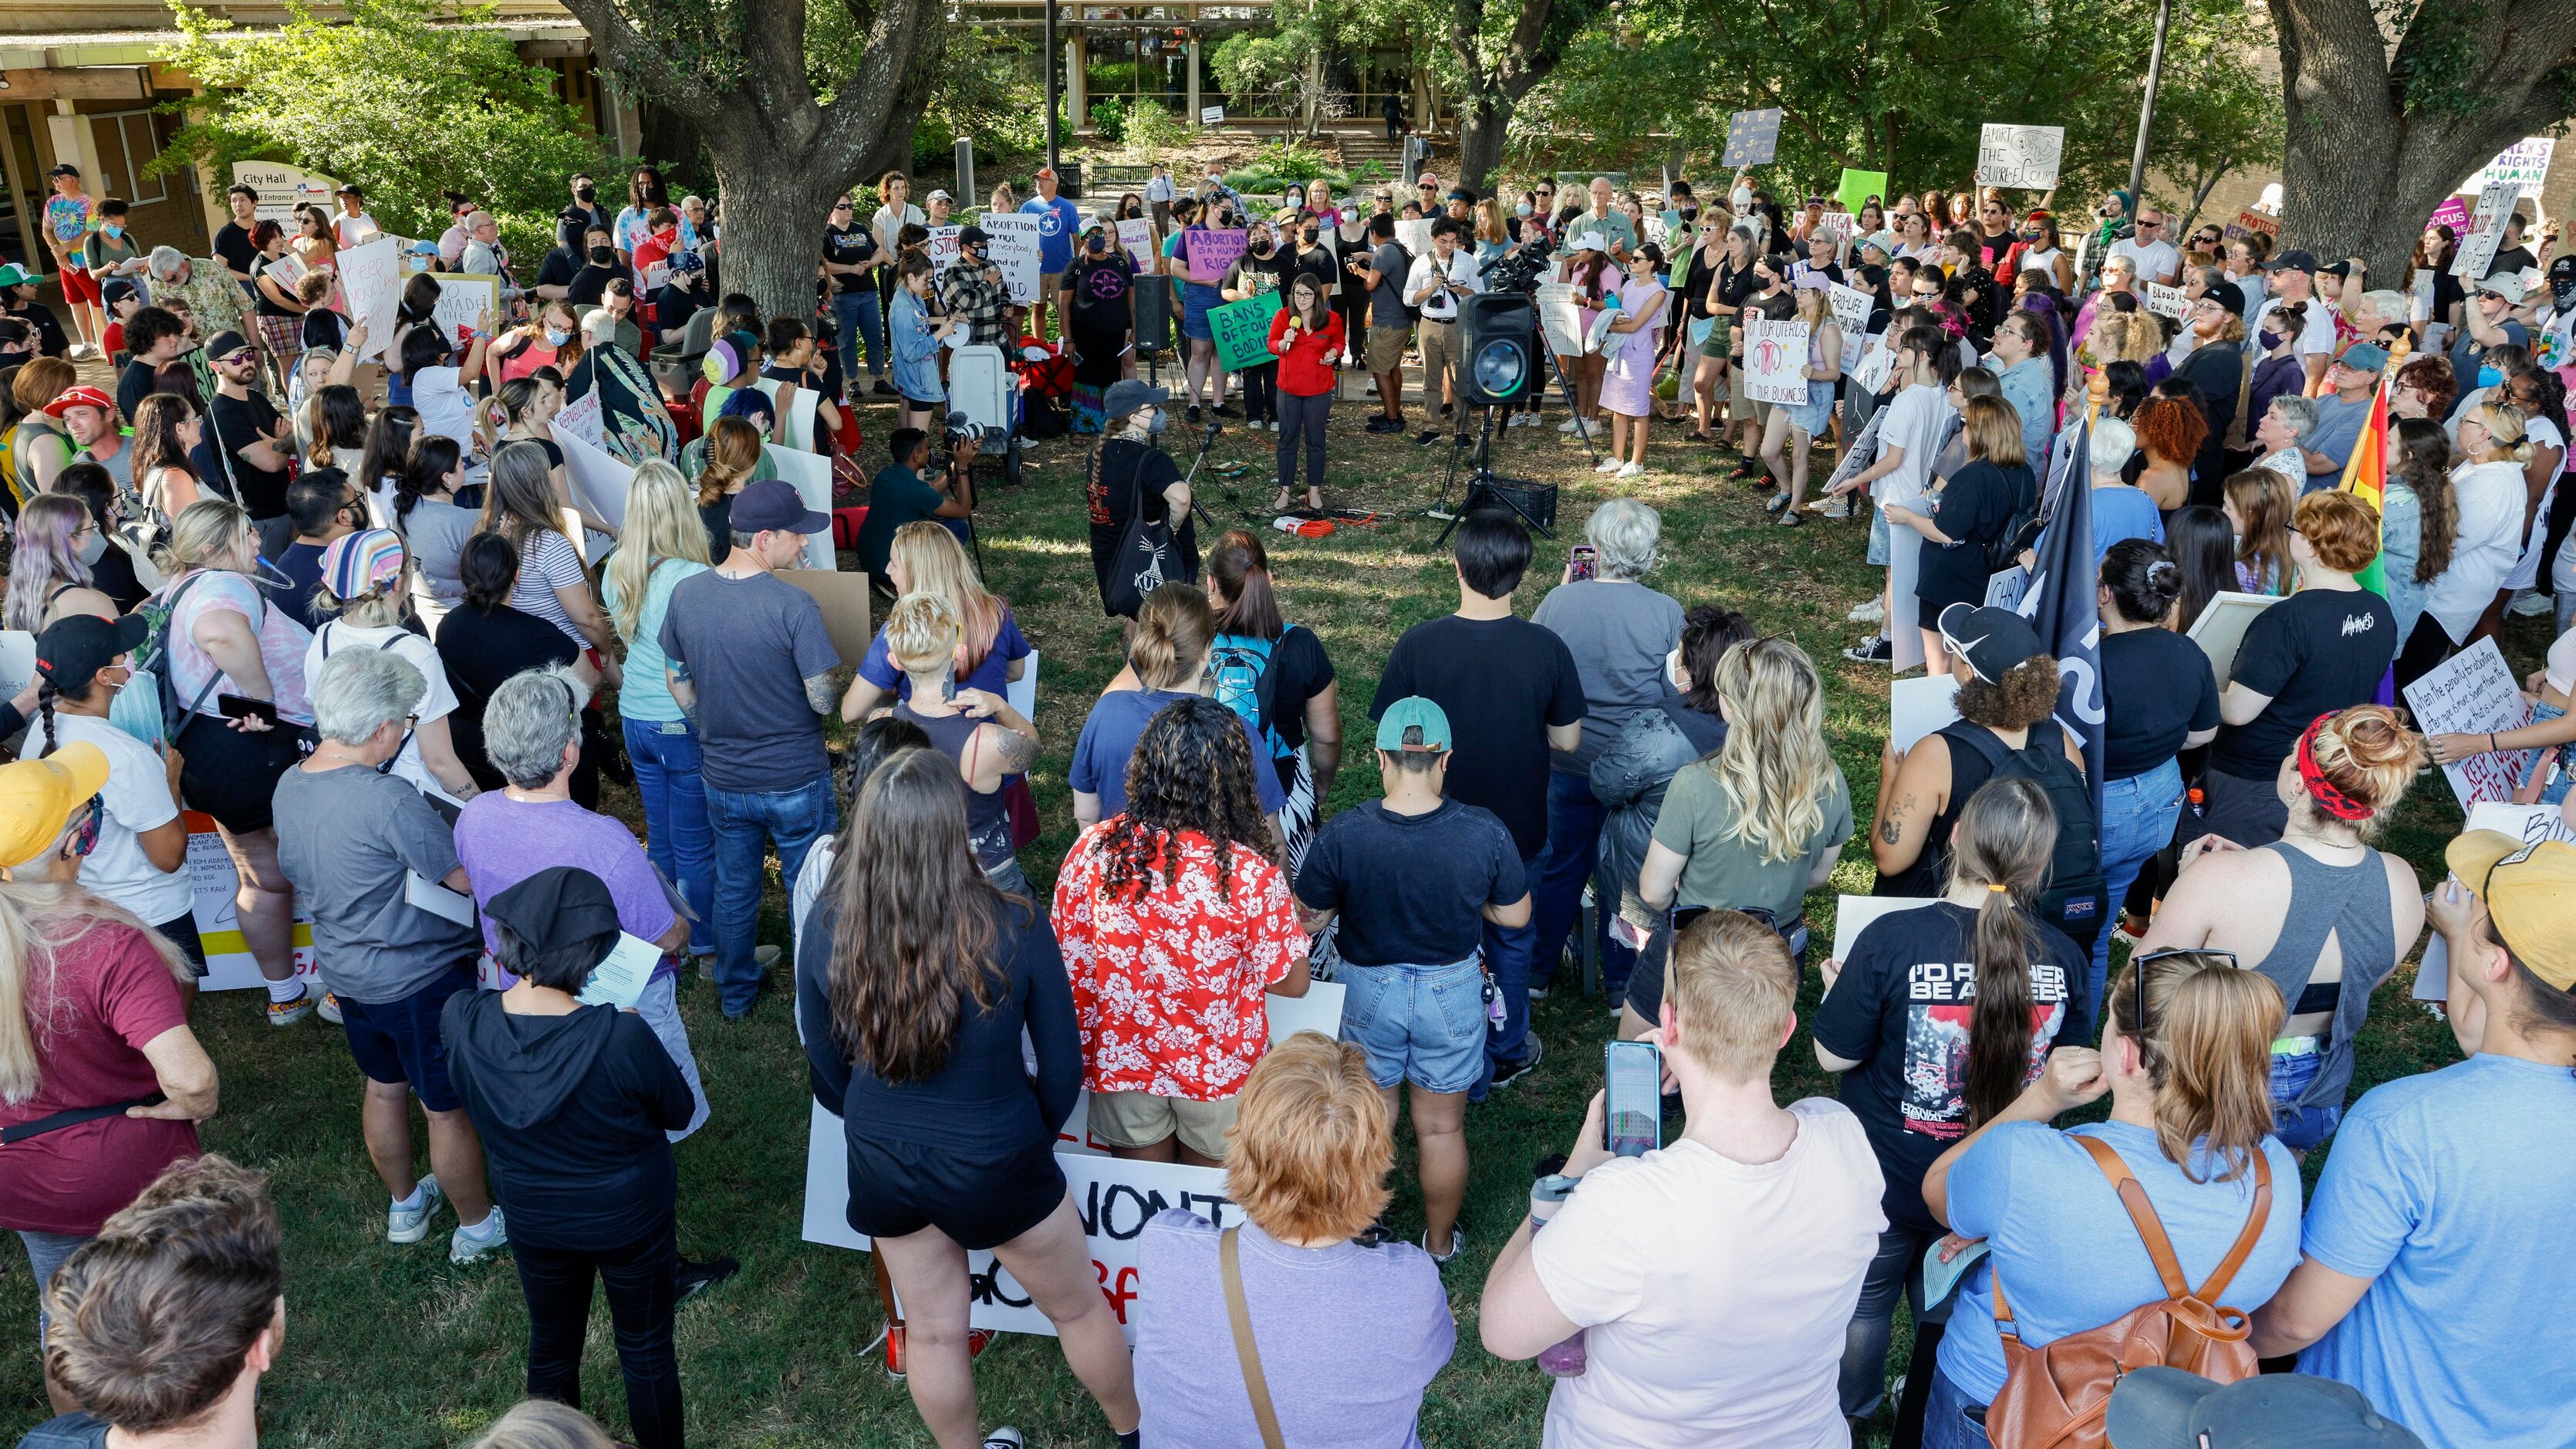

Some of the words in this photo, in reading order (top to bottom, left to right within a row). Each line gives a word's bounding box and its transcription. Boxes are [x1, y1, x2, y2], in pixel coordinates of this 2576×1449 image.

[1983, 127, 2014, 144] ABORT
[1982, 147, 2006, 162] THE
[2498, 154, 2546, 169] RIGHTS
[243, 174, 263, 186] City
[266, 174, 287, 184] Hall
[2484, 169, 2543, 181] HUMAN
[2480, 187, 2500, 208] GET
[986, 220, 1038, 232] ABORTION
[2239, 212, 2280, 236] PROTECT
[2466, 213, 2494, 235] BLOODY
[999, 235, 1017, 243] not
[1190, 231, 1248, 246] ABORTION
[2474, 234, 2490, 252] OFF
[996, 244, 1032, 257] everybody
[1011, 259, 1020, 268] of
[441, 297, 483, 312] MADE
[1832, 292, 1862, 313] PRO-LIFE
[2151, 302, 2161, 311] ON
[2165, 305, 2180, 316] YOUR
[439, 311, 468, 322] THE
[1219, 302, 1266, 329] BANS
[1837, 315, 1853, 333] THAT
[1221, 325, 1247, 343] OFF
[1745, 319, 1757, 336] NOT
[1760, 320, 1774, 337] YOUR
[1775, 322, 1808, 338] UTERUS
[1756, 384, 1769, 400] YOUR
[1772, 386, 1806, 403] BUSINESS
[559, 393, 598, 429] REPUBLICANS
[2406, 687, 2435, 714] When
[2427, 677, 2446, 701] the
[2444, 663, 2466, 702] penalty
[2461, 657, 2473, 689] for
[2471, 646, 2497, 670] aborting
[2425, 711, 2441, 734] after
[2441, 708, 2455, 724] rape
[2453, 704, 2460, 714] is
[2458, 696, 2470, 711] more
[2481, 674, 2497, 692] than
[2494, 667, 2506, 682] the
[2470, 707, 2486, 721] that
[2483, 704, 2490, 714] is
[2488, 691, 2503, 711] when
[2503, 685, 2513, 708] you
[2491, 712, 2510, 731] women
[2461, 752, 2488, 790] KEEP
[211, 884, 228, 893] RAGE
[1909, 963, 1947, 983] I'D
[1909, 982, 1953, 1000] BE
